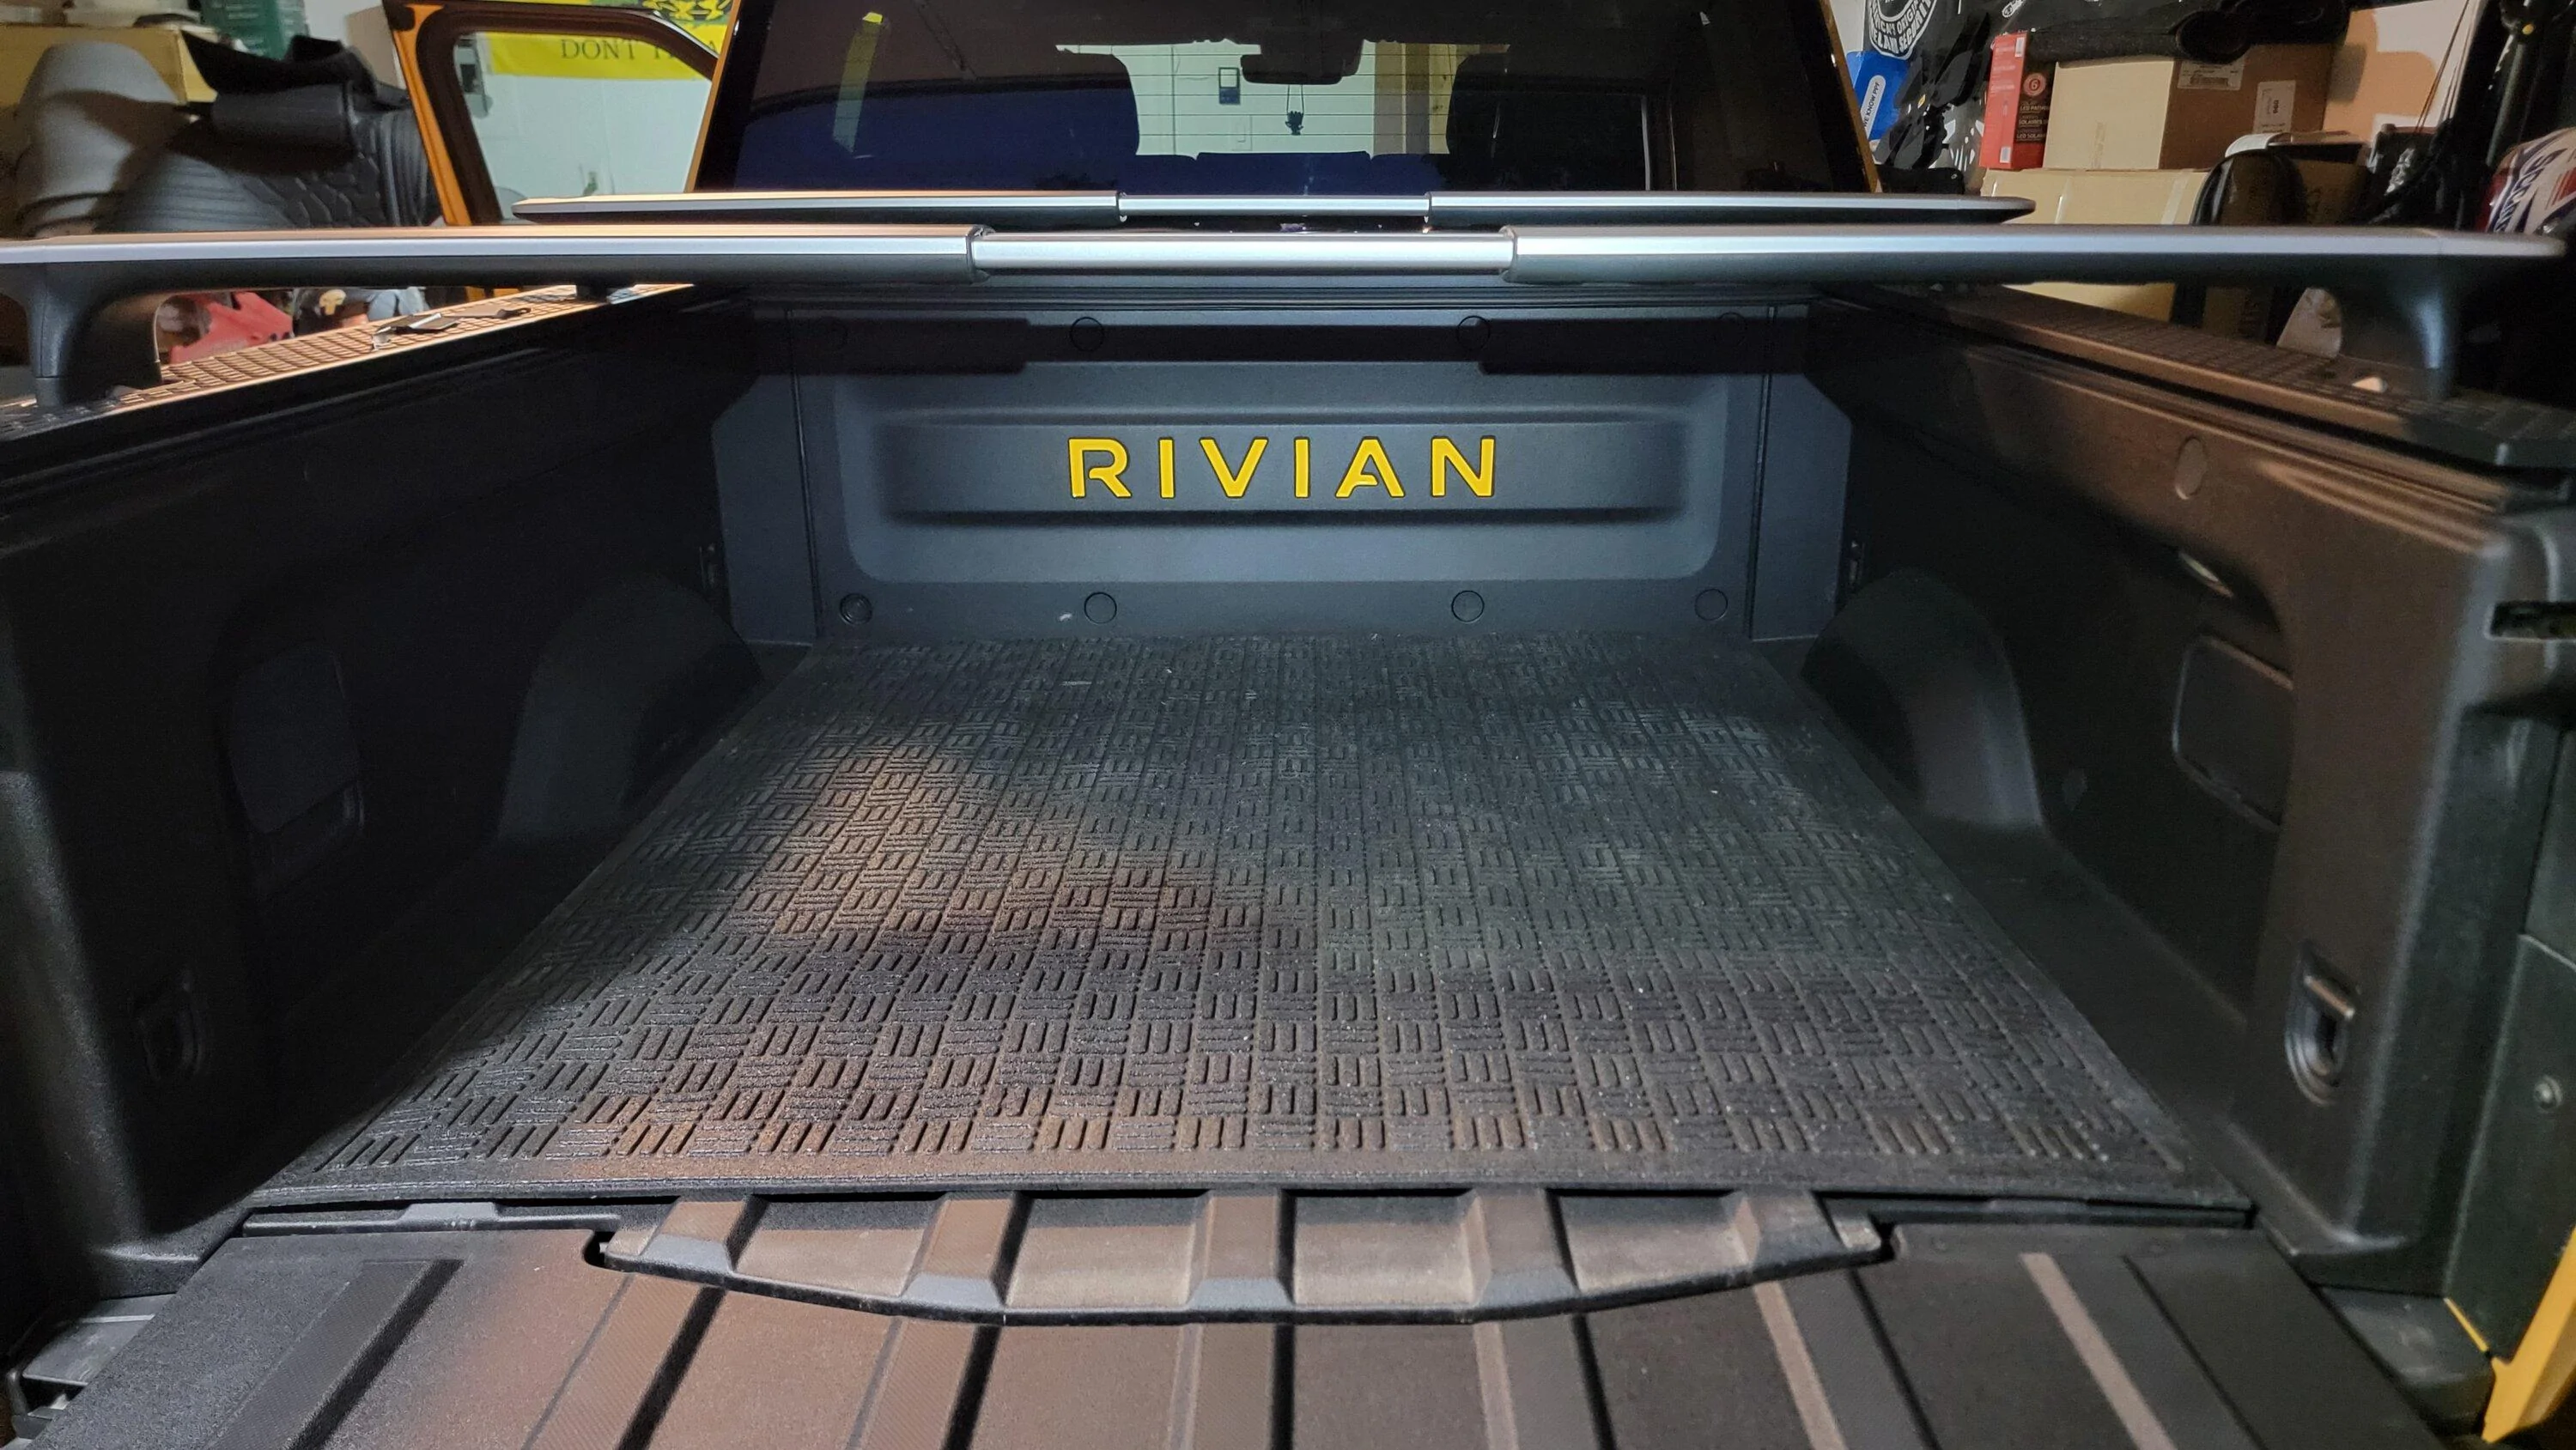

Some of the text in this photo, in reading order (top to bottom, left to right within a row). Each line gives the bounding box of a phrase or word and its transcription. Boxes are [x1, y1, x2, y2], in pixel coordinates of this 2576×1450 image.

[561, 39, 635, 60] DONT
[1868, 95, 1876, 117] KNOW
[1067, 437, 1495, 499] RIVIAN
